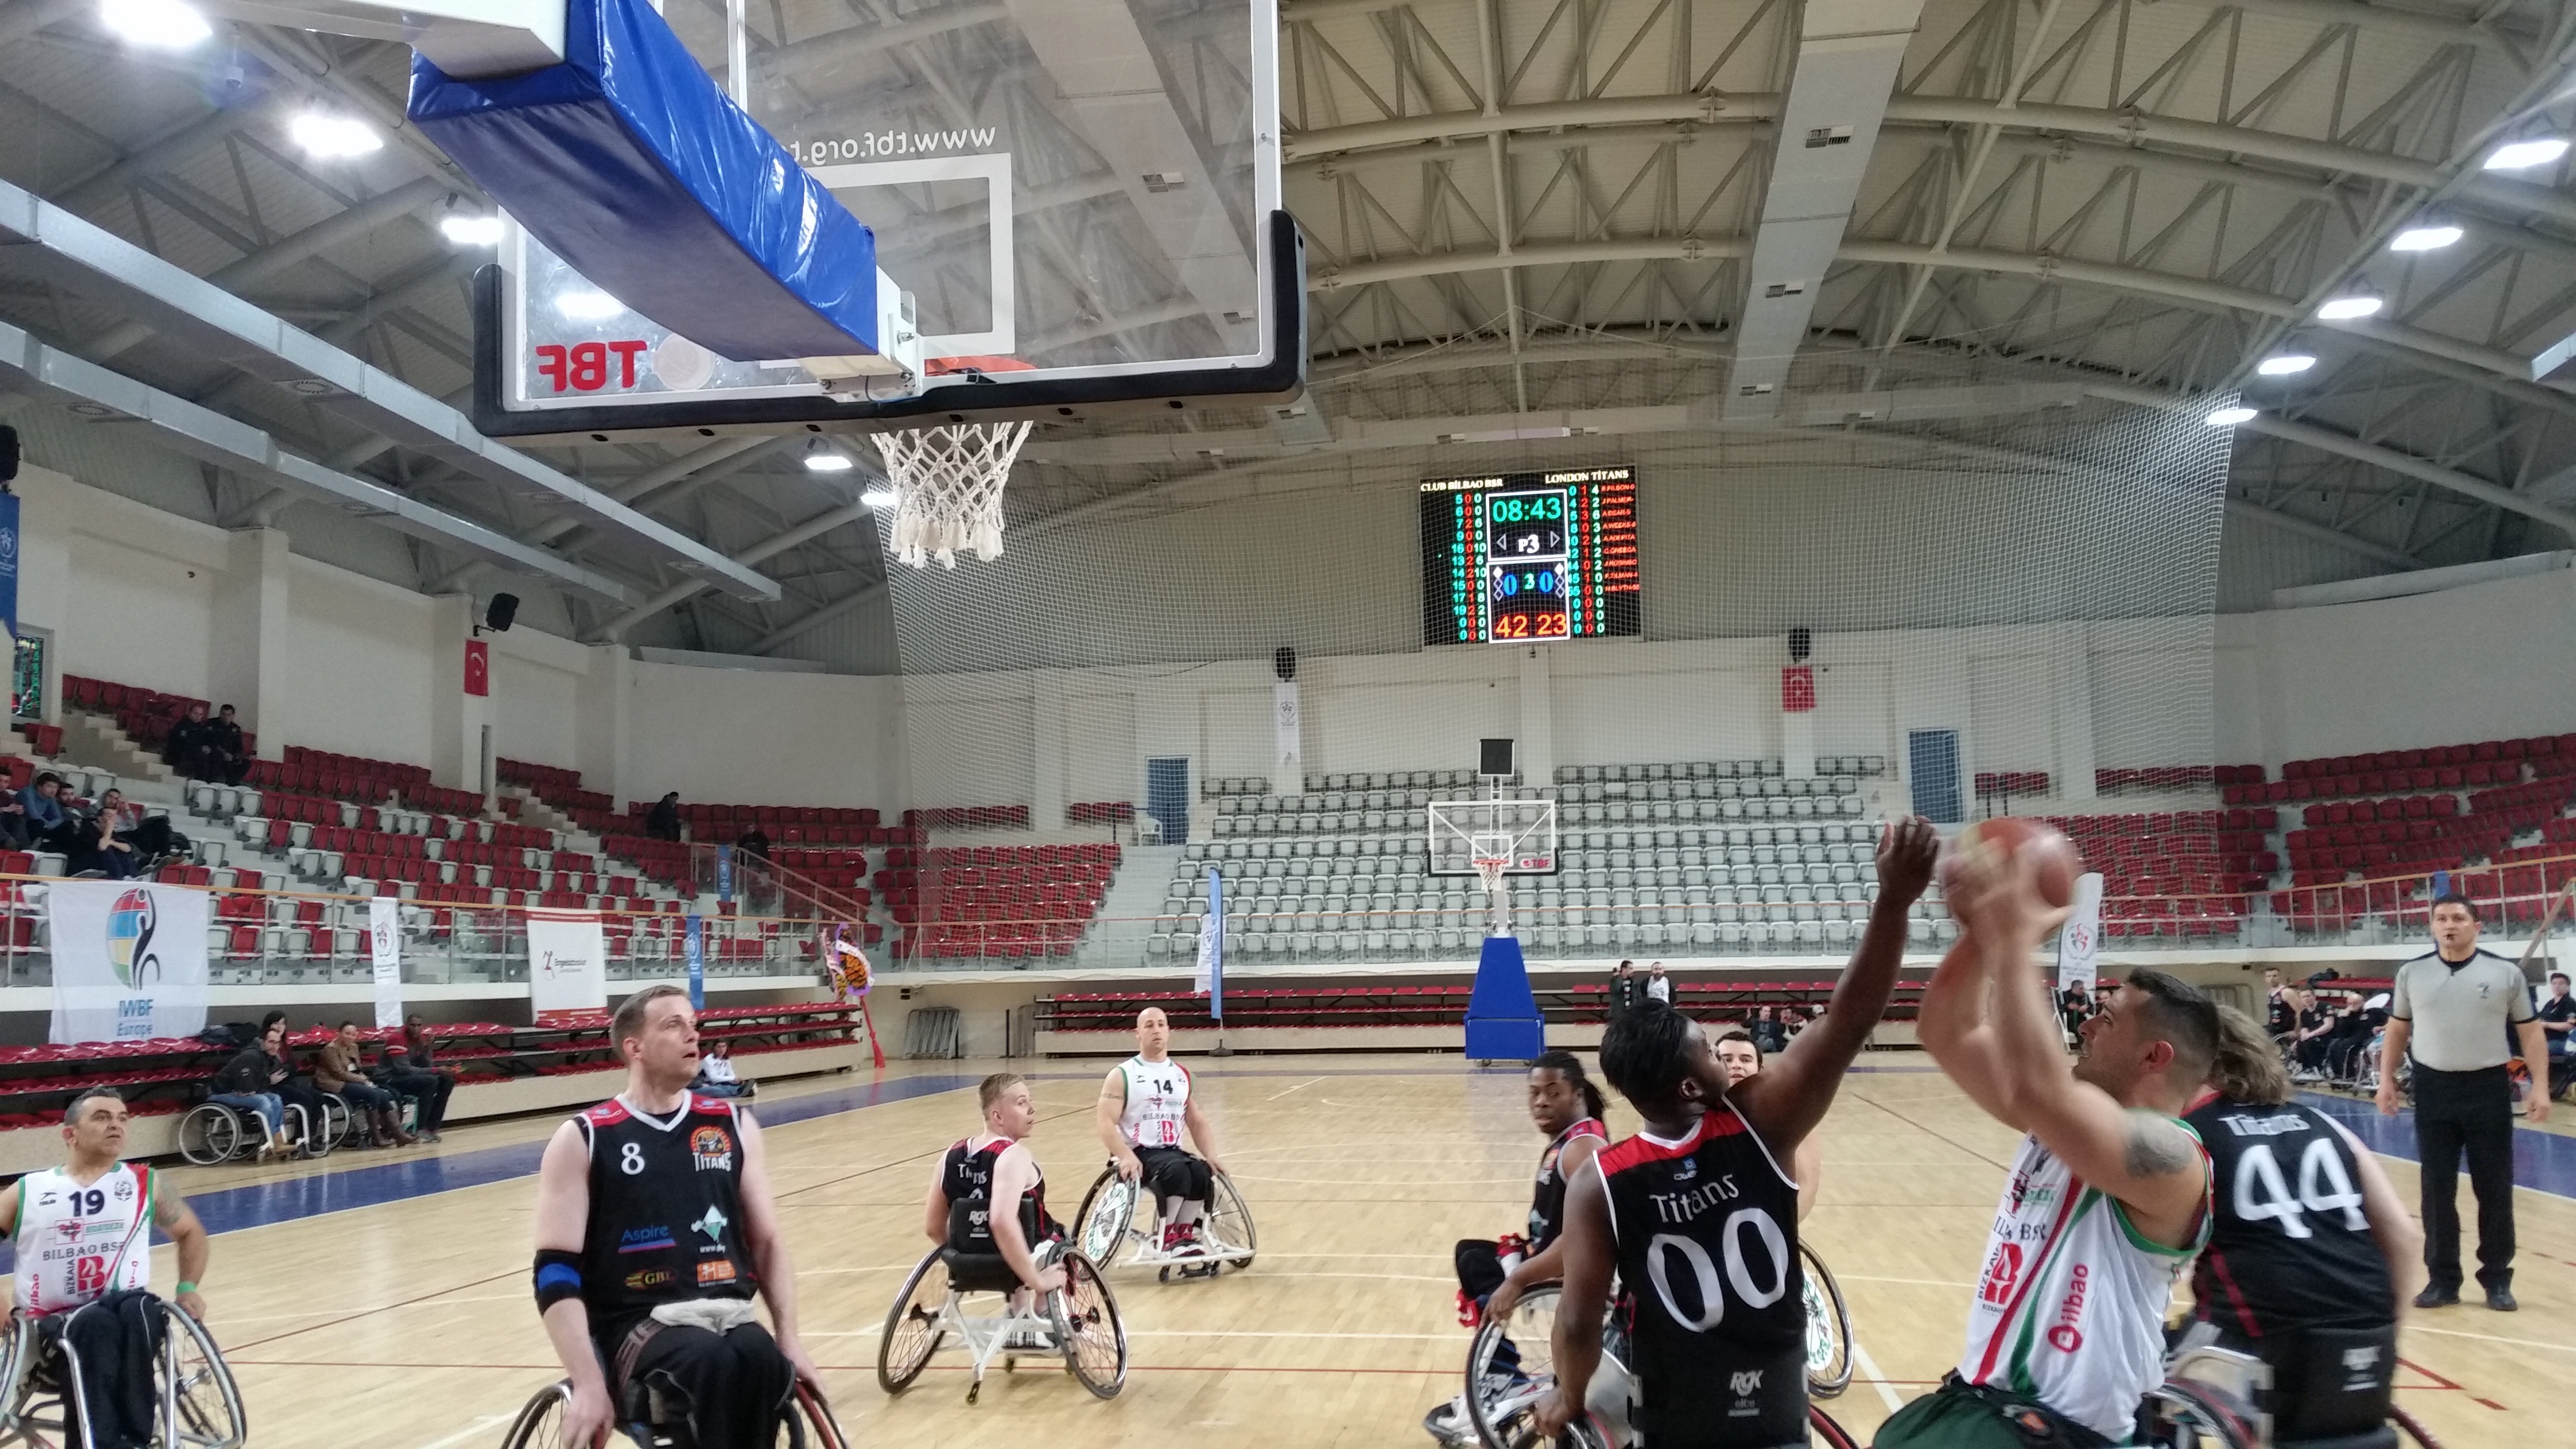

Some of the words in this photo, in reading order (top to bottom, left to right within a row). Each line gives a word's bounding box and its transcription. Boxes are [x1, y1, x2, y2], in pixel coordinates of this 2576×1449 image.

[1545, 472, 1589, 483] LONDON
[1420, 482, 1446, 491] CLUB
[1569, 486, 1577, 496] 0
[1581, 485, 1586, 495] 1
[1592, 484, 1599, 495] 4
[1465, 494, 1471, 503] 0
[1474, 493, 1481, 503] 0
[1569, 499, 1577, 508] 4
[1581, 498, 1588, 507] 2
[1593, 498, 1599, 507] 2
[1465, 507, 1472, 516] 0
[1475, 505, 1482, 515] 0
[1493, 497, 1561, 522] 08:43
[1581, 510, 1588, 520] 3
[1593, 510, 1600, 519] 6
[1456, 519, 1464, 529] 7
[1465, 519, 1472, 528] 2
[1475, 518, 1482, 528] 6
[1582, 522, 1589, 532] 0
[1593, 522, 1600, 532] 3
[1466, 531, 1472, 541] 0
[1475, 531, 1483, 540] 0
[1582, 535, 1590, 545] 2
[1594, 534, 1601, 545] 4
[1466, 544, 1473, 553] 0
[1474, 543, 1486, 553] 10
[1584, 547, 1588, 557] 1
[1594, 547, 1601, 557] 2
[1466, 556, 1473, 565] 2
[1476, 555, 1483, 565] 6
[1583, 560, 1590, 570] 0
[1594, 560, 1602, 570] 2
[1452, 568, 1465, 578] 14
[1467, 568, 1474, 578] 2
[1474, 567, 1487, 578] 10
[1584, 573, 1590, 583] 1
[1595, 573, 1602, 582] 0
[1452, 580, 1465, 590] 15
[1467, 581, 1474, 590] 0
[1477, 580, 1484, 590] 0
[1503, 574, 1517, 596] 0
[1539, 571, 1554, 593] 0
[1585, 585, 1591, 596] 0
[1595, 585, 1603, 595] 0
[1453, 593, 1465, 603] 17
[1468, 593, 1474, 602] 1
[1573, 598, 1580, 609] 0
[1585, 598, 1592, 608] 0
[1596, 598, 1603, 608] 0
[1468, 606, 1475, 615] 2
[1478, 605, 1485, 615] 2
[1574, 611, 1581, 621] 0
[1586, 611, 1593, 620] 0
[1596, 610, 1604, 620] 0
[1459, 617, 1467, 628] 0
[1469, 618, 1475, 628] 0
[1478, 617, 1486, 628] 0
[1495, 615, 1528, 638] 42
[1537, 613, 1567, 635] 23
[1574, 624, 1581, 634] 0
[1586, 624, 1593, 633] 0
[1597, 623, 1605, 633] 0
[1460, 629, 1467, 640] 0
[1468, 630, 1476, 640] 0
[1479, 630, 1486, 640] 0
[1531, 859, 1550, 868] TBF
[119, 999, 153, 1017] IWBF
[117, 1023, 153, 1038] Europe
[1153, 1079, 1173, 1094] 14
[621, 1142, 645, 1175] 8
[692, 1151, 732, 1172] TITANS
[2233, 1138, 2372, 1238] 44
[68, 1189, 105, 1217] 19
[1649, 1174, 1739, 1223] Titans
[621, 1225, 669, 1241] Aspire
[43, 1244, 97, 1261] BILBAO
[1647, 1208, 1789, 1334] 00
